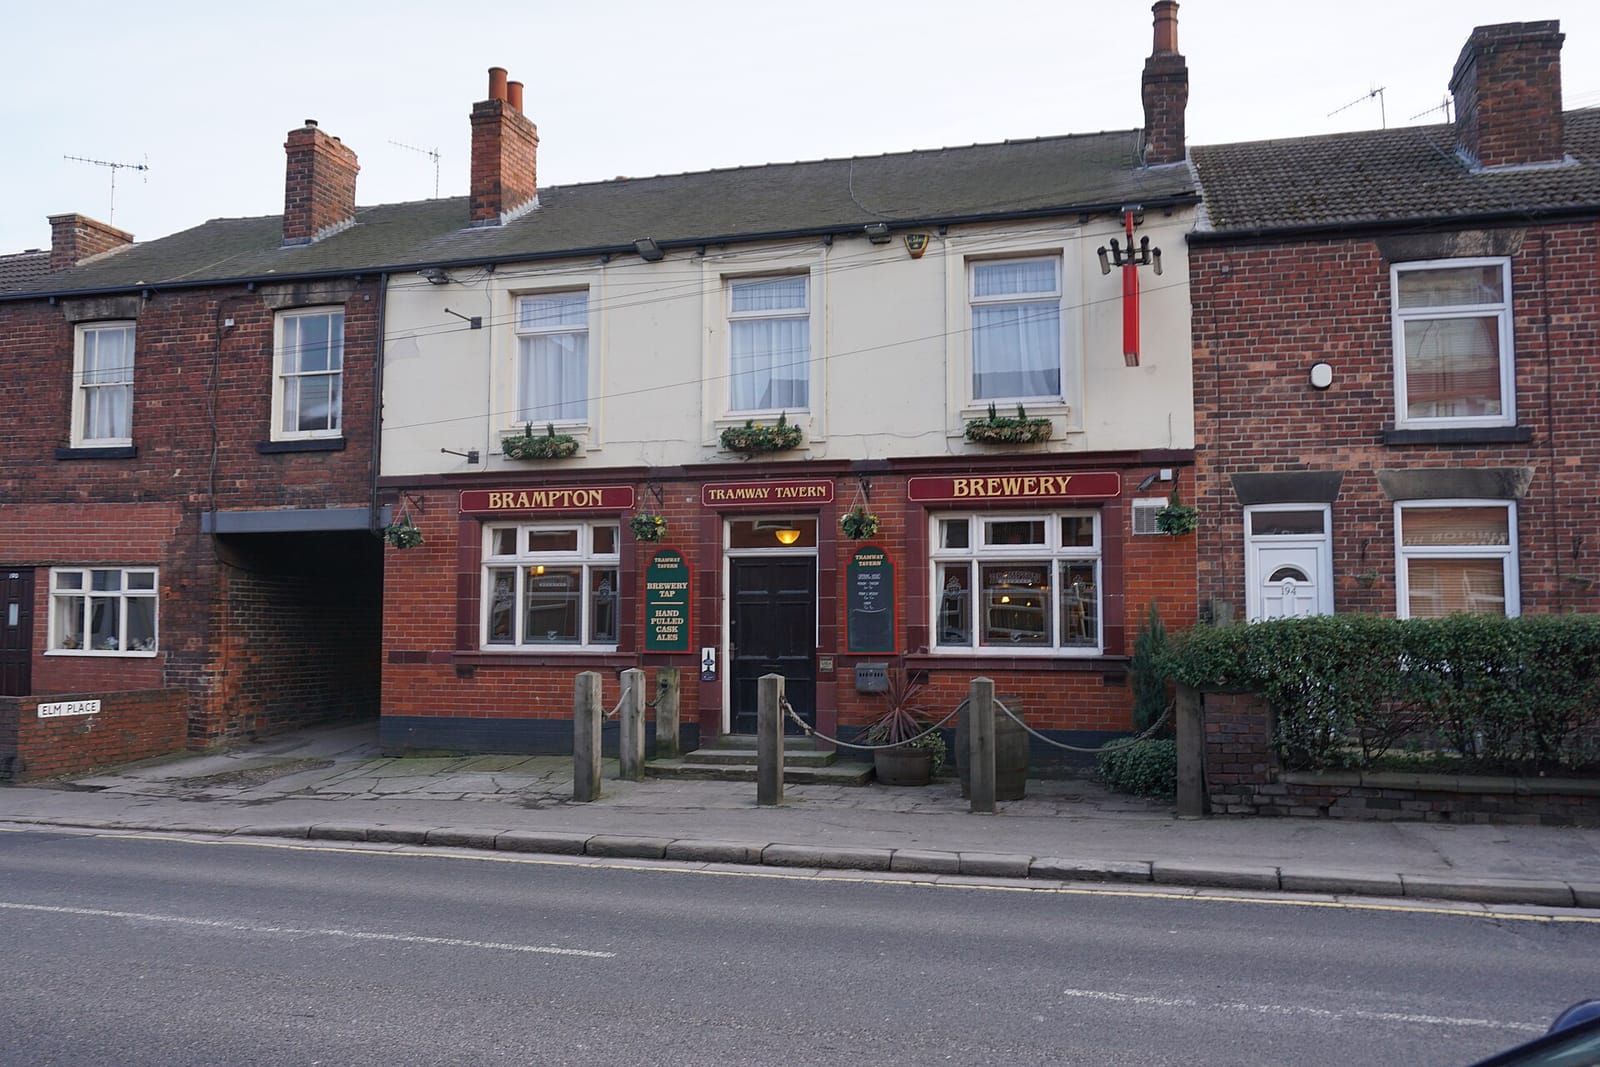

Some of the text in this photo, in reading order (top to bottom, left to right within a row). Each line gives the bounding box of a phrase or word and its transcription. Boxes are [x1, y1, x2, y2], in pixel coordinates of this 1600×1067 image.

[953, 476, 1072, 496] BREWERY
[708, 486, 826, 500] TRAMWAY TAVERN
[488, 489, 603, 509] BRAMPTON
[655, 609, 680, 617] HAND
[650, 617, 684, 625] PULLED
[655, 625, 679, 633] CASK
[656, 633, 678, 641] ALES
[42, 702, 96, 715] ELM PLACE
